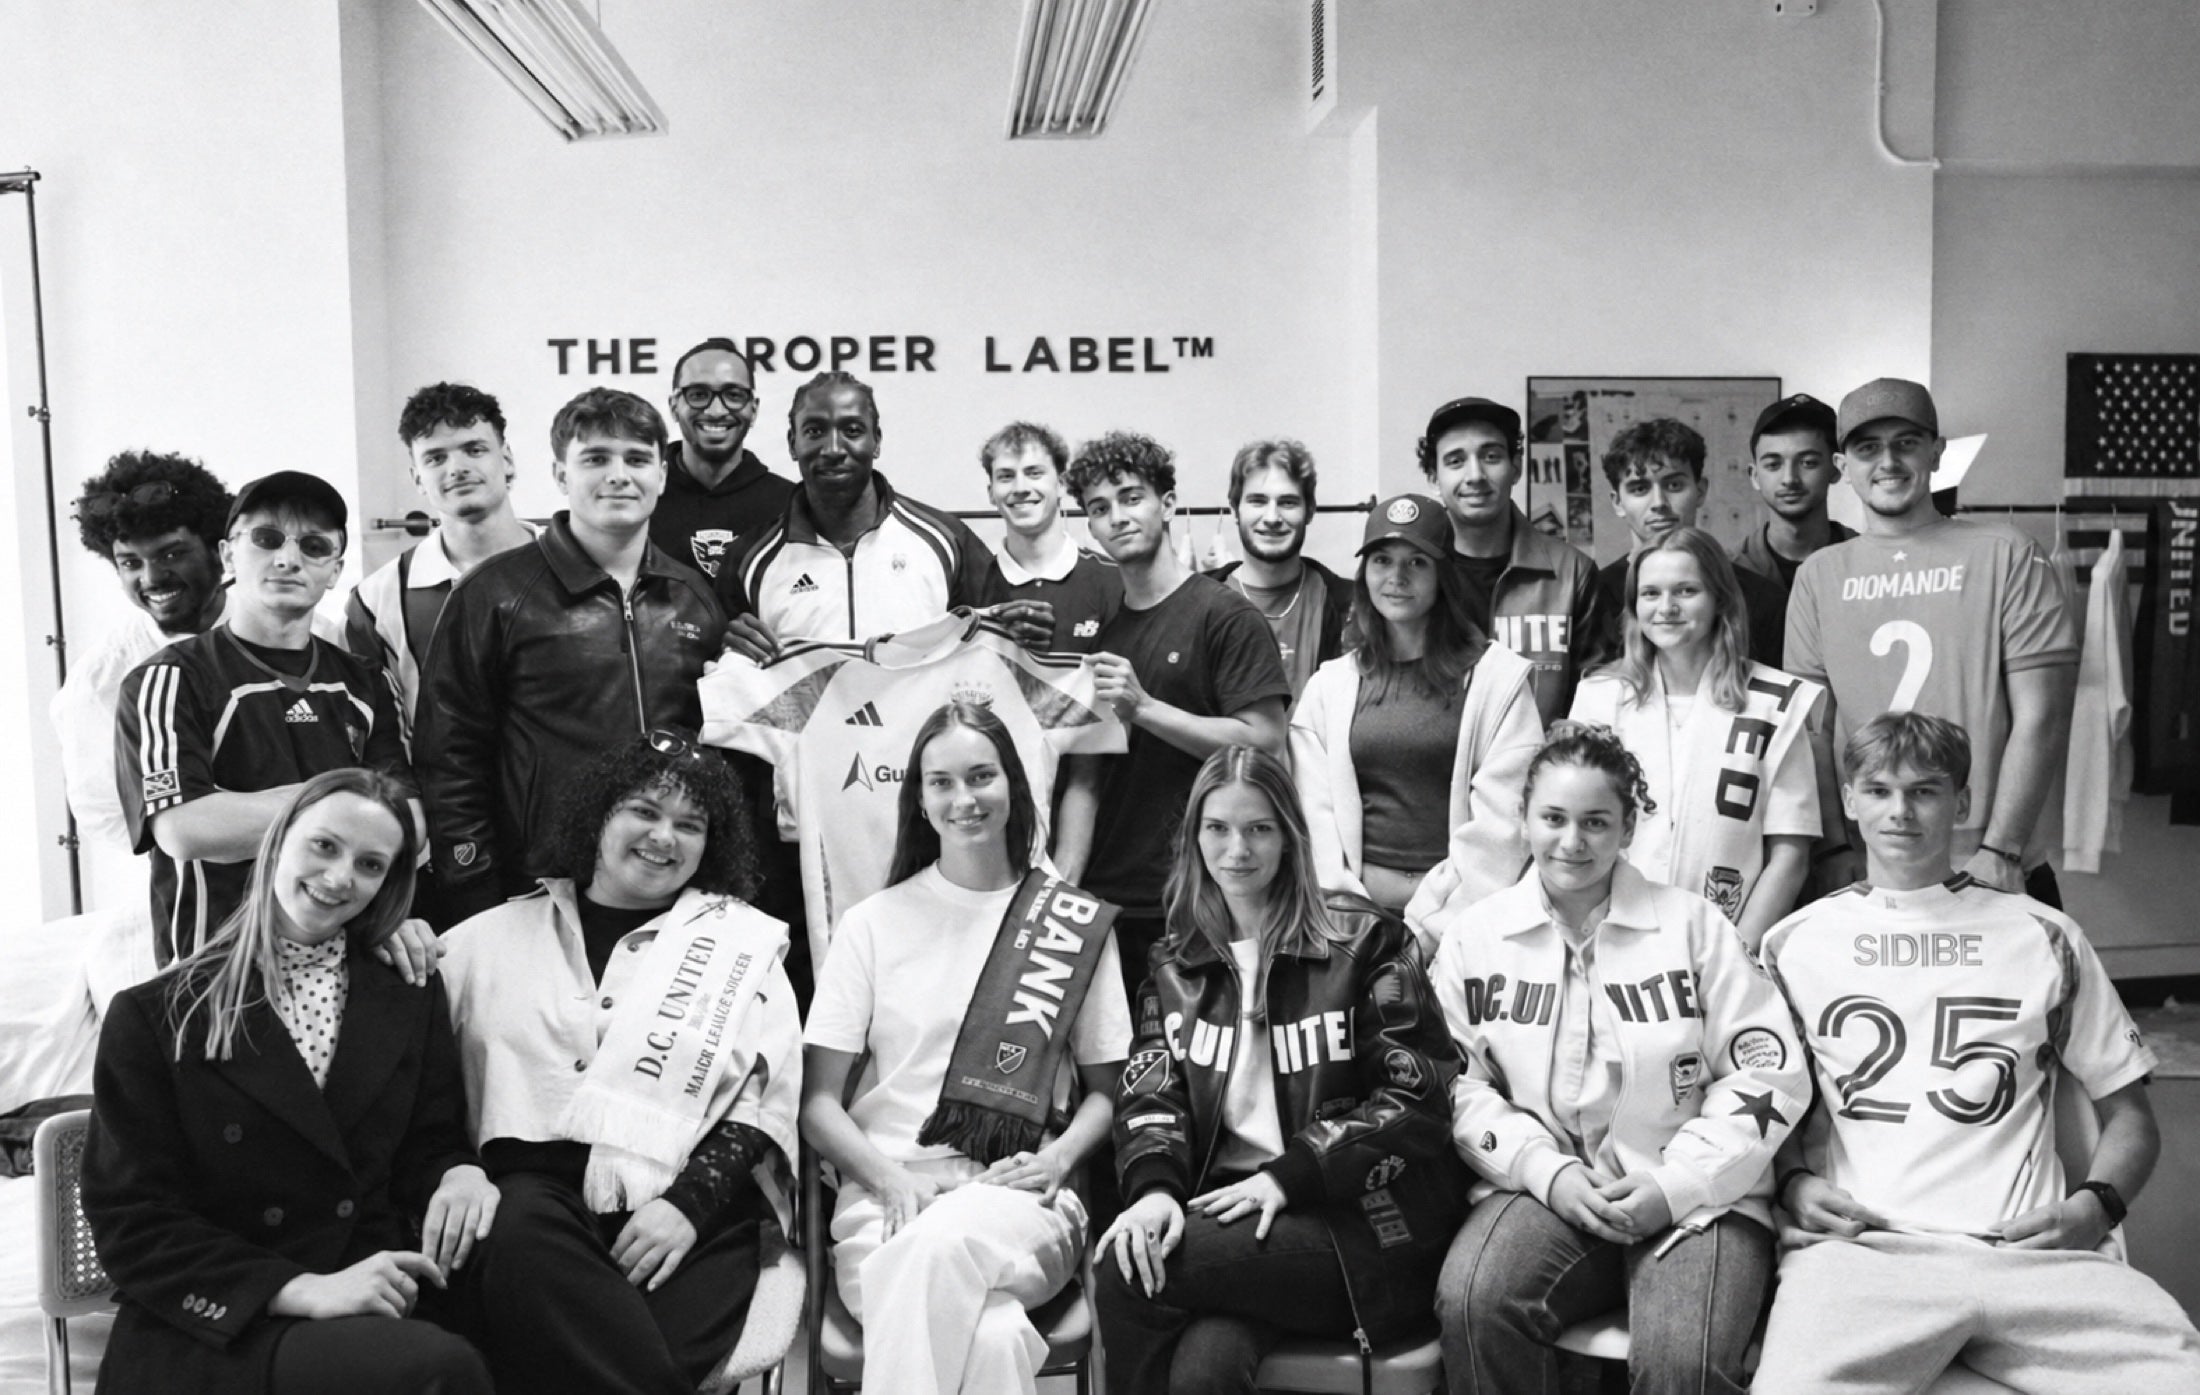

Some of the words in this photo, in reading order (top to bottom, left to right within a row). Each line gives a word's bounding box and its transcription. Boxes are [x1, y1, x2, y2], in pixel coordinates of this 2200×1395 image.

[547, 338, 658, 375] THE
[707, 336, 936, 372] ROPER
[875, 765, 907, 783] Gu
[1004, 892, 1101, 1041] BANK
[1853, 933, 1983, 968] SIDIBE
[634, 1031, 678, 1082] D.C.
[657, 936, 716, 1021] UNITED
[1818, 994, 2023, 1128] 25
